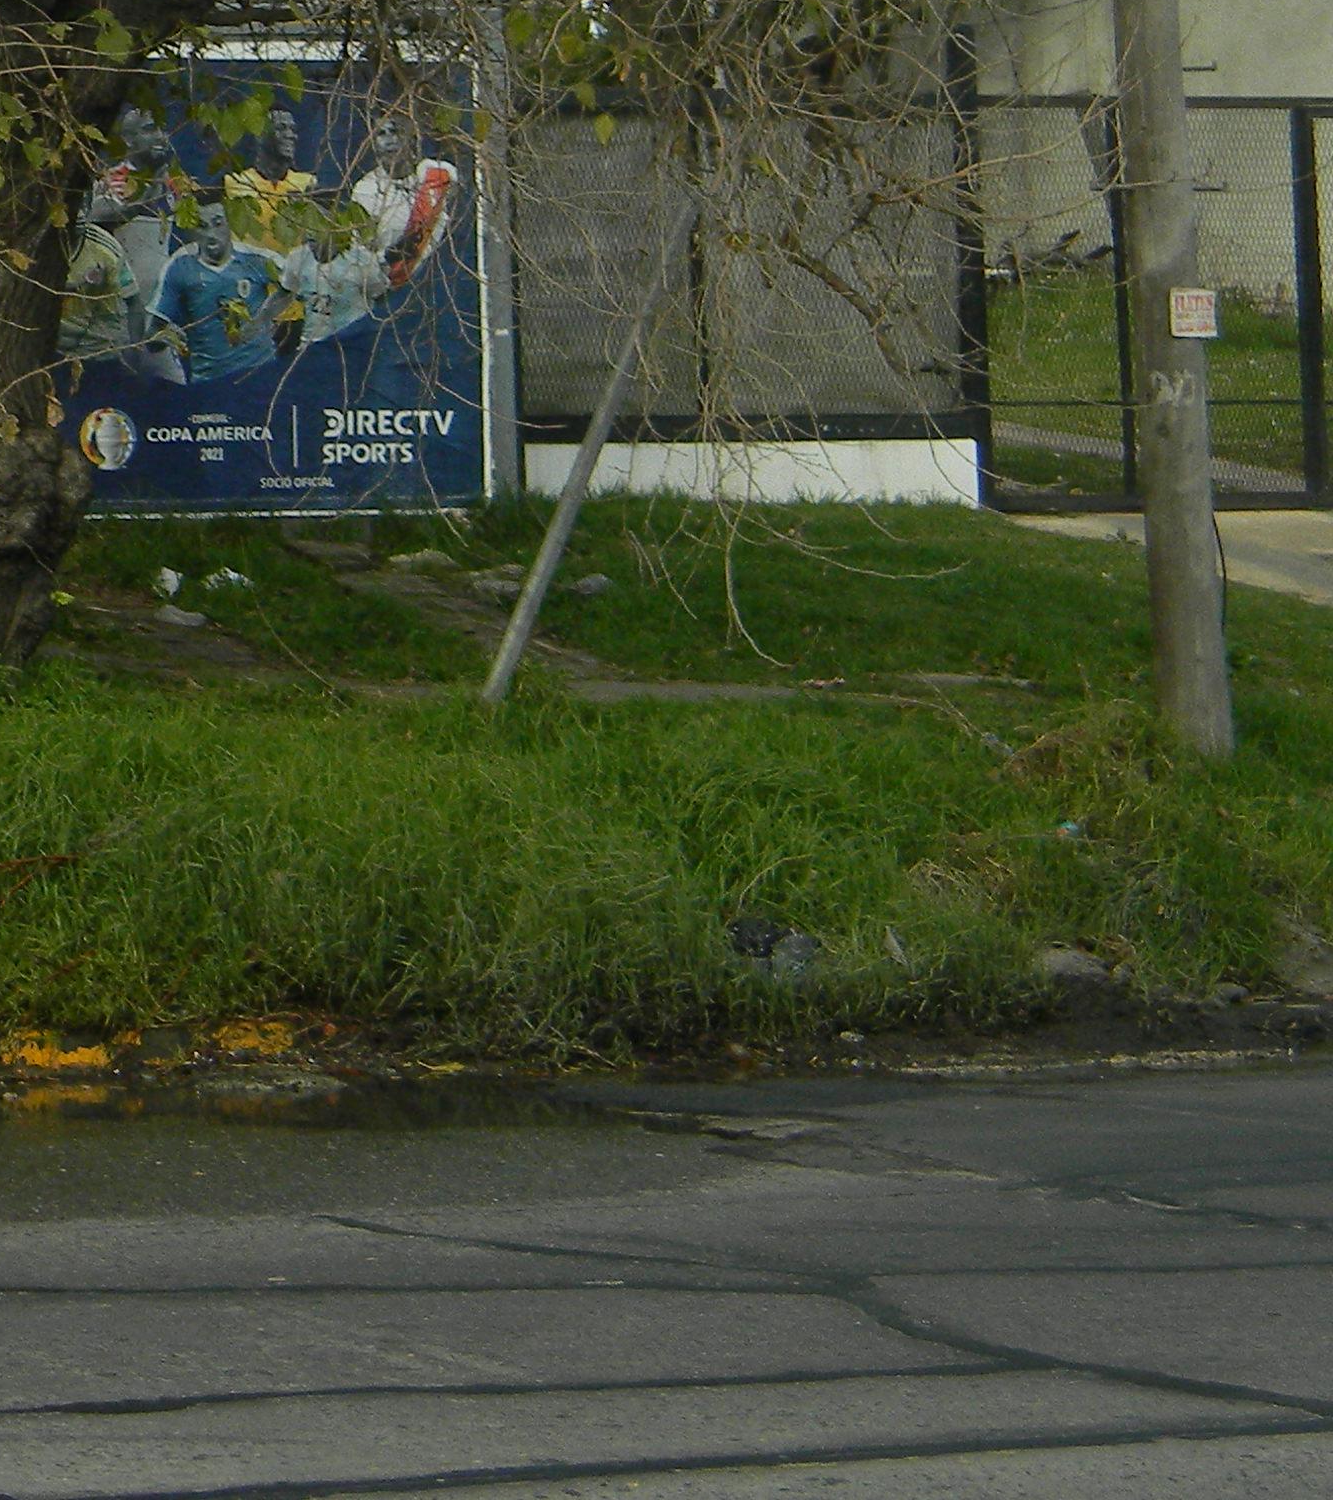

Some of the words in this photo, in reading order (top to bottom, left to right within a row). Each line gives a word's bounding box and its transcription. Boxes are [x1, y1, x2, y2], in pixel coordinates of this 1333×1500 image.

[322, 408, 455, 437] DIRECTV
[146, 427, 193, 442] COPA
[195, 425, 273, 442] AMERICA
[322, 443, 414, 464] SPORTS
[260, 476, 292, 489] SOCIO
